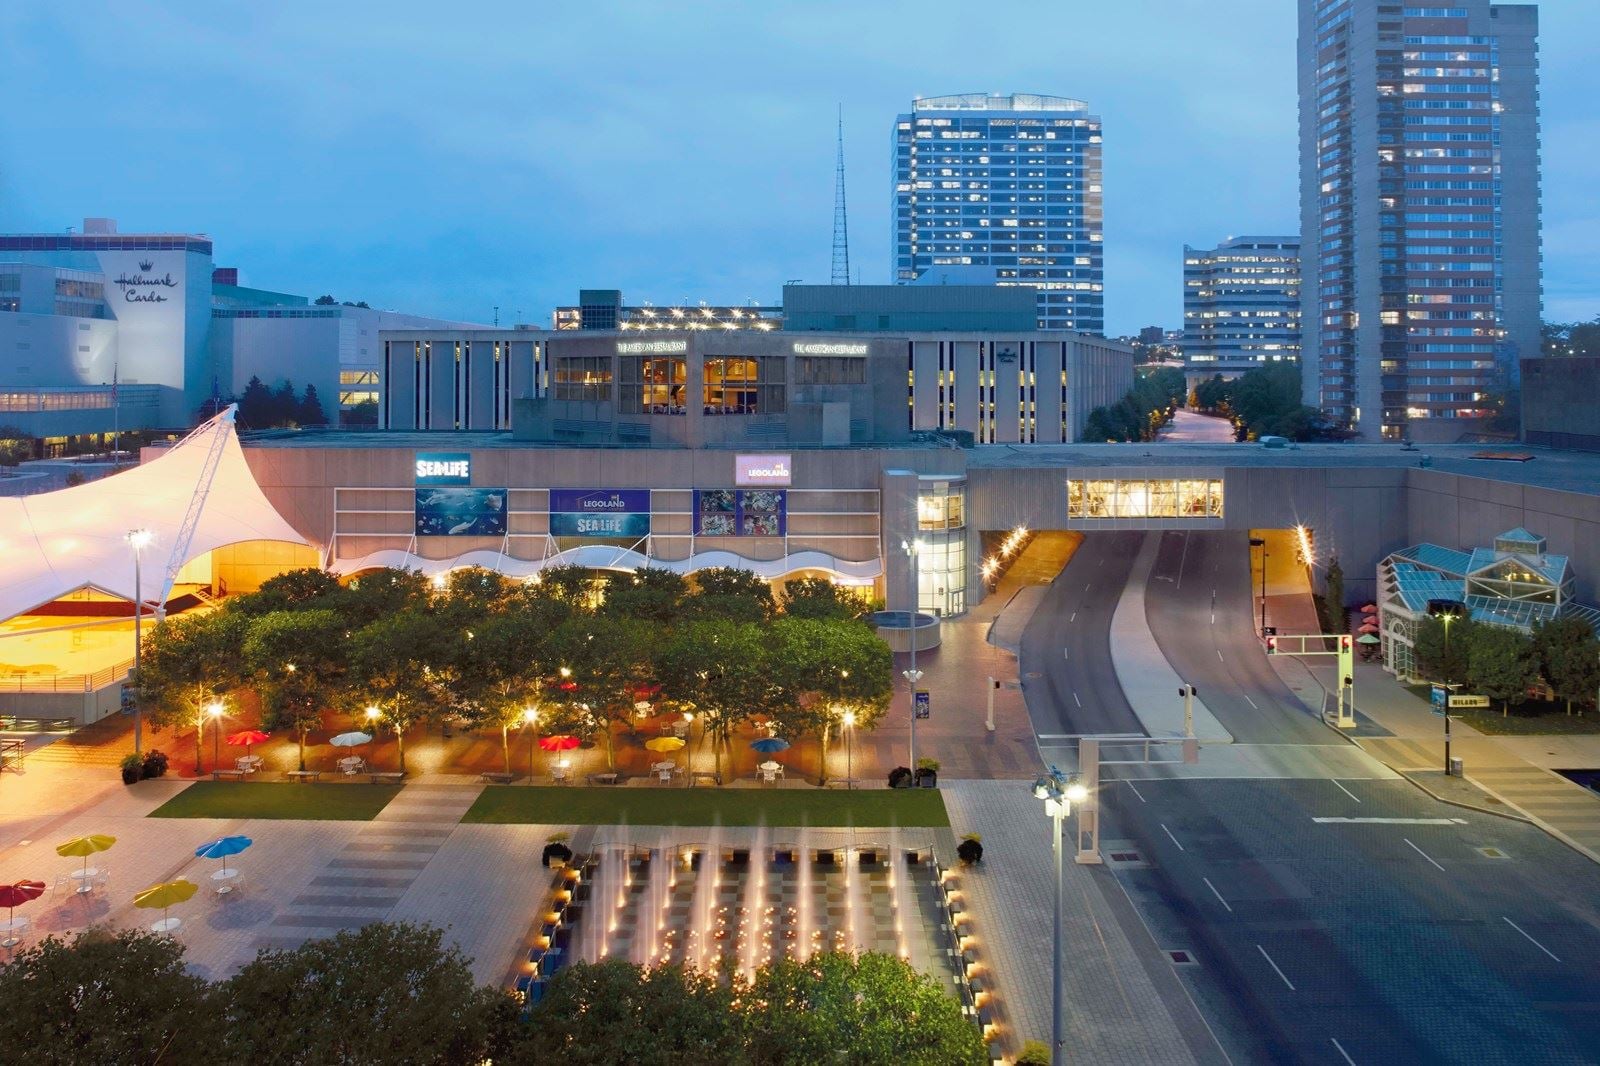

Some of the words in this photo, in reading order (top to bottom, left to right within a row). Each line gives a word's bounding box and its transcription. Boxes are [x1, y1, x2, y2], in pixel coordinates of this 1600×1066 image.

[114, 272, 178, 292] Hallmark
[126, 289, 168, 302] Cards
[416, 460, 442, 477] SEA
[748, 463, 789, 476] LEGOLAND
[584, 494, 625, 508] LEGOLAND
[577, 518, 598, 532] SEA
